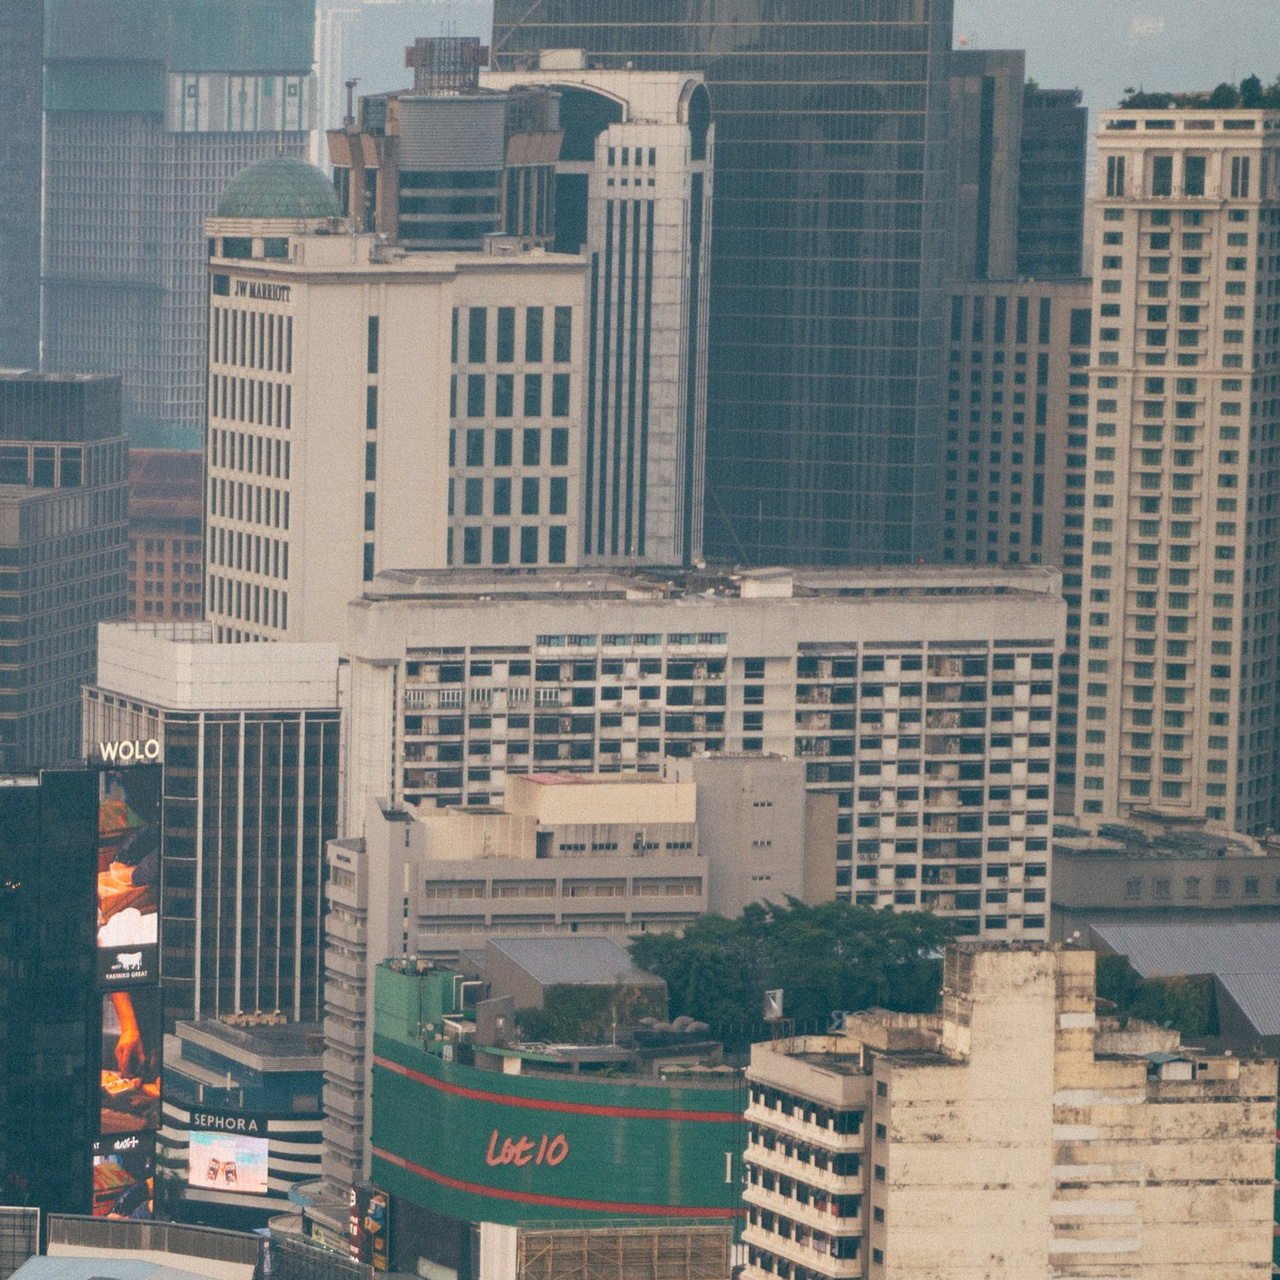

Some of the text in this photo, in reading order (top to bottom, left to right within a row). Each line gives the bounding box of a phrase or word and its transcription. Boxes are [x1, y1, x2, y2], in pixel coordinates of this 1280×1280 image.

[235, 280, 291, 302] JW MARRIOTT
[100, 739, 160, 761] WOLO
[194, 1112, 258, 1131] SEPHORA
[535, 1132, 569, 1166] 10
